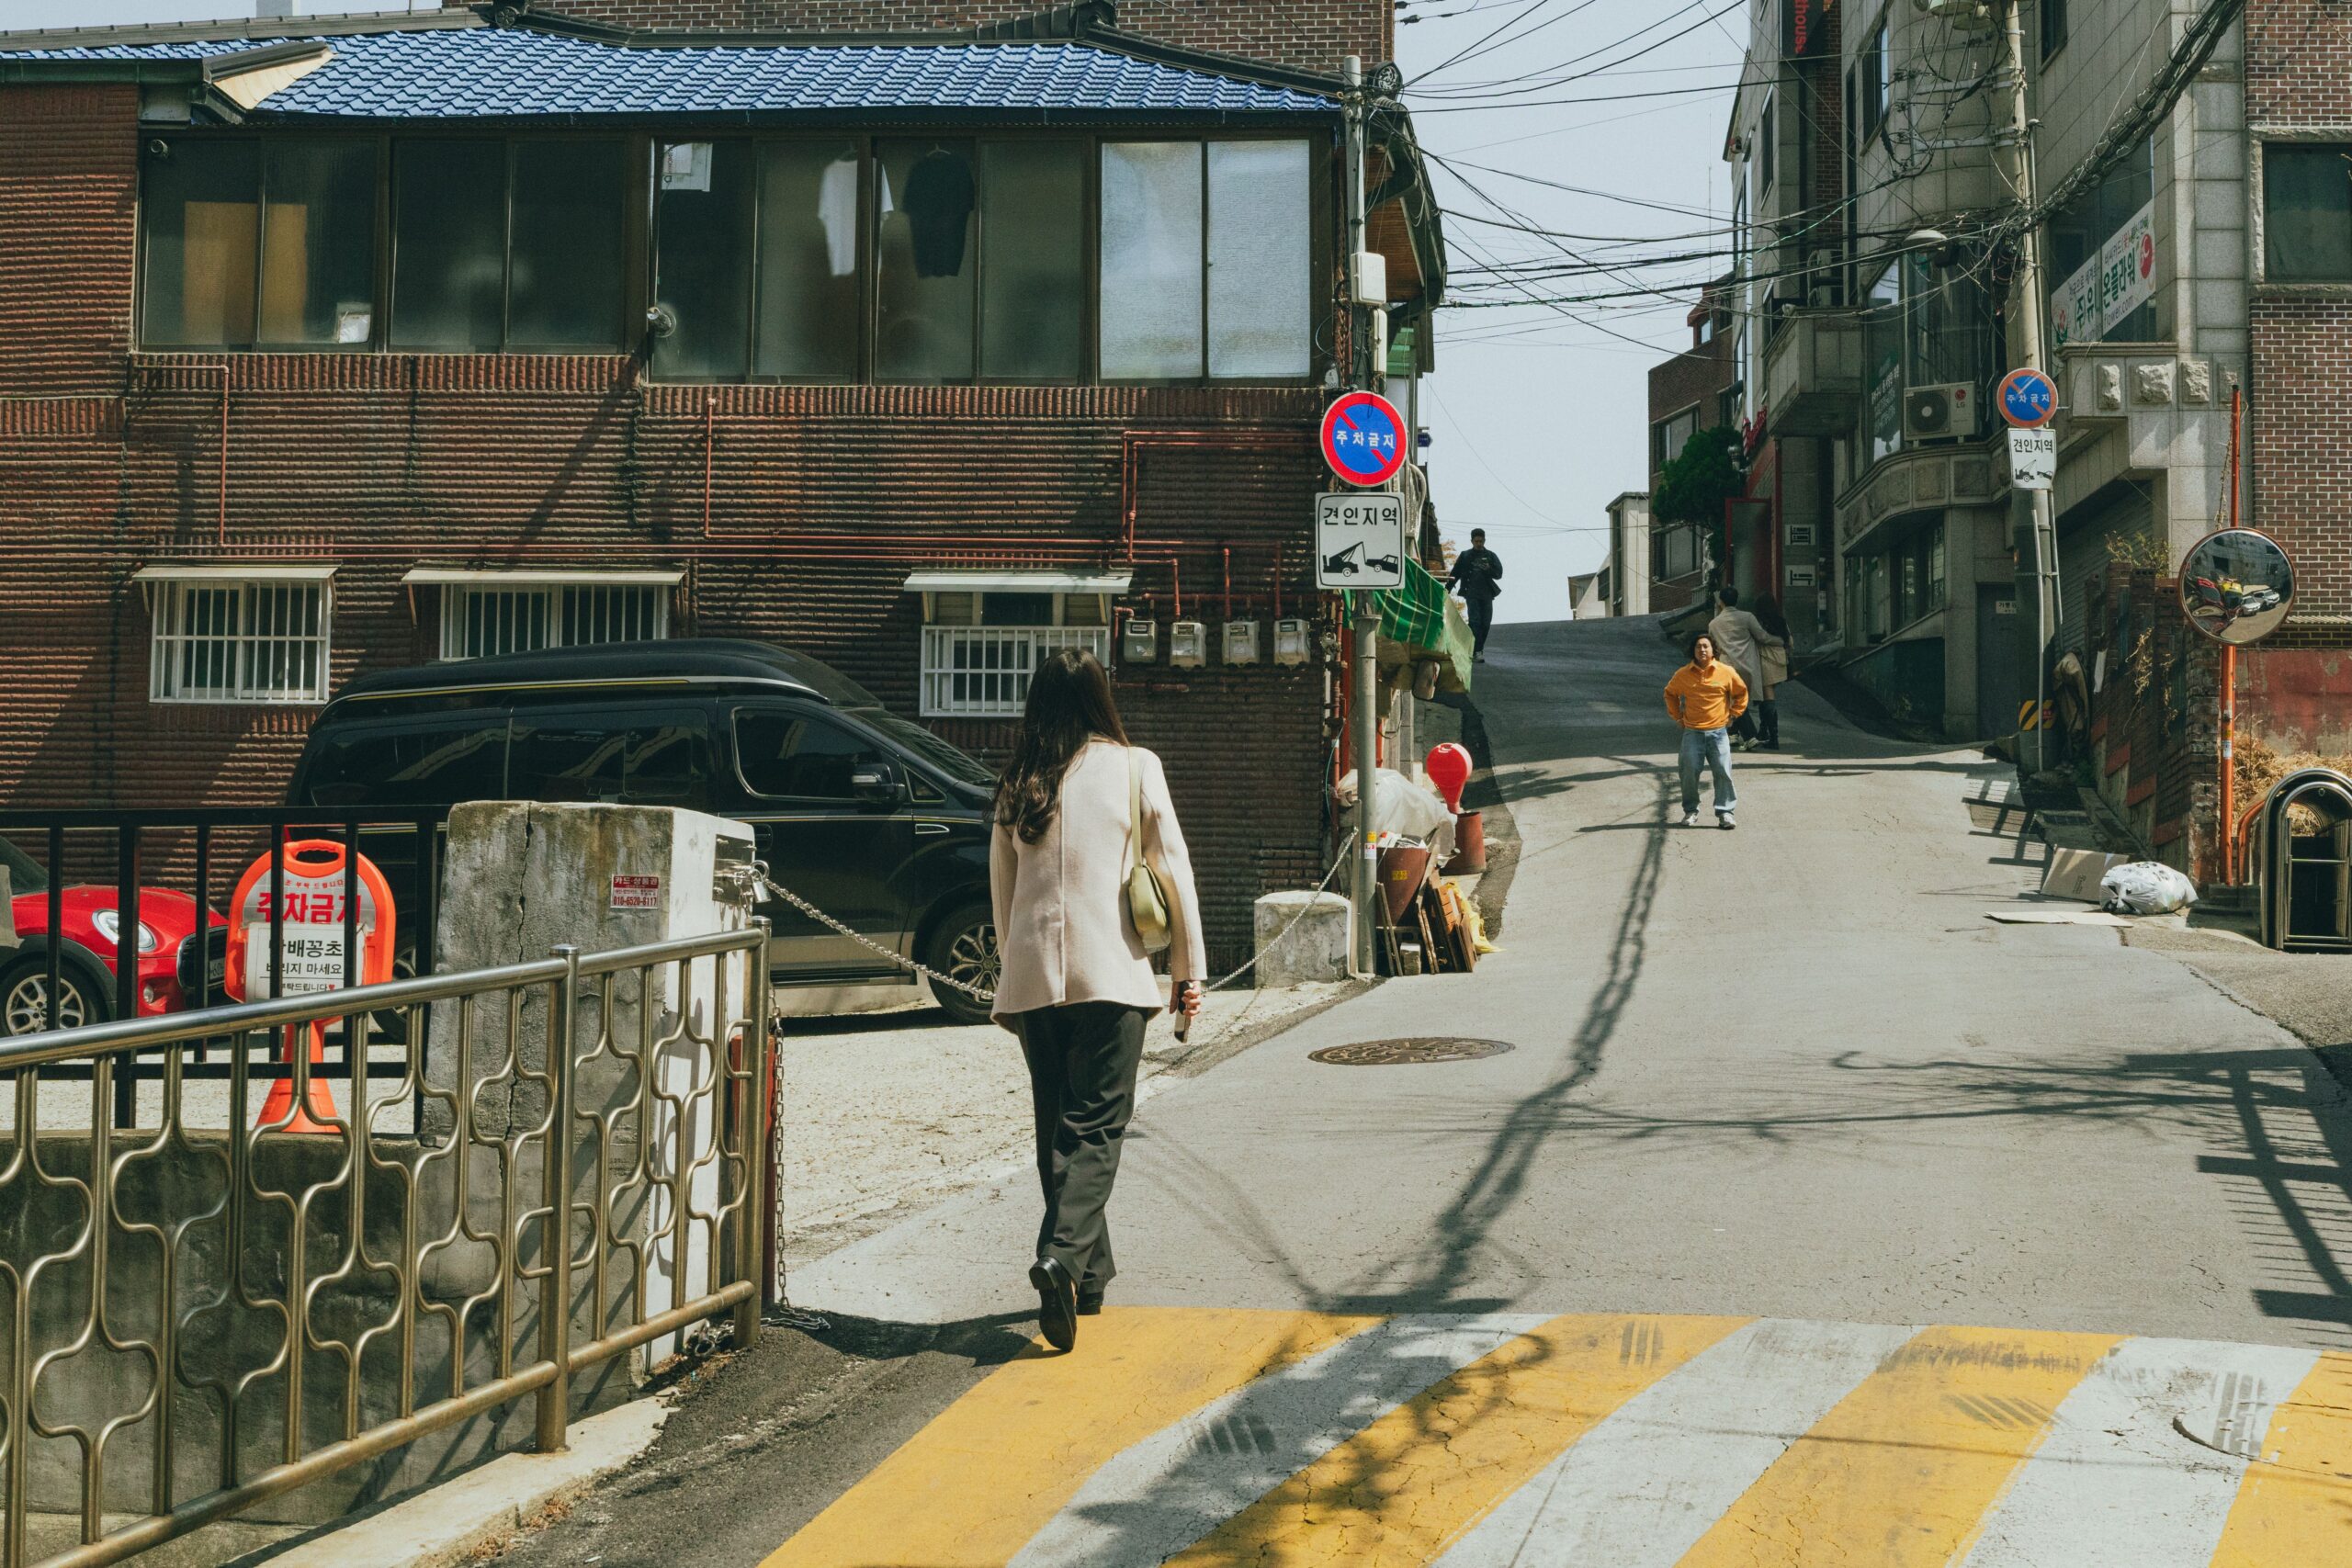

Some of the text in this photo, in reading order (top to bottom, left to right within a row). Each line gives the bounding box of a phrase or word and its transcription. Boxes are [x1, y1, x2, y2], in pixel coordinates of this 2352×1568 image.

[2007, 393, 2050, 404] 주차금지
[1336, 430, 1394, 448] 주차금지
[2014, 438, 2053, 454] 견인지역
[1323, 507, 1397, 526] 견인지역
[269, 939, 343, 958] 배꽁초
[306, 963, 343, 976] 마세요
